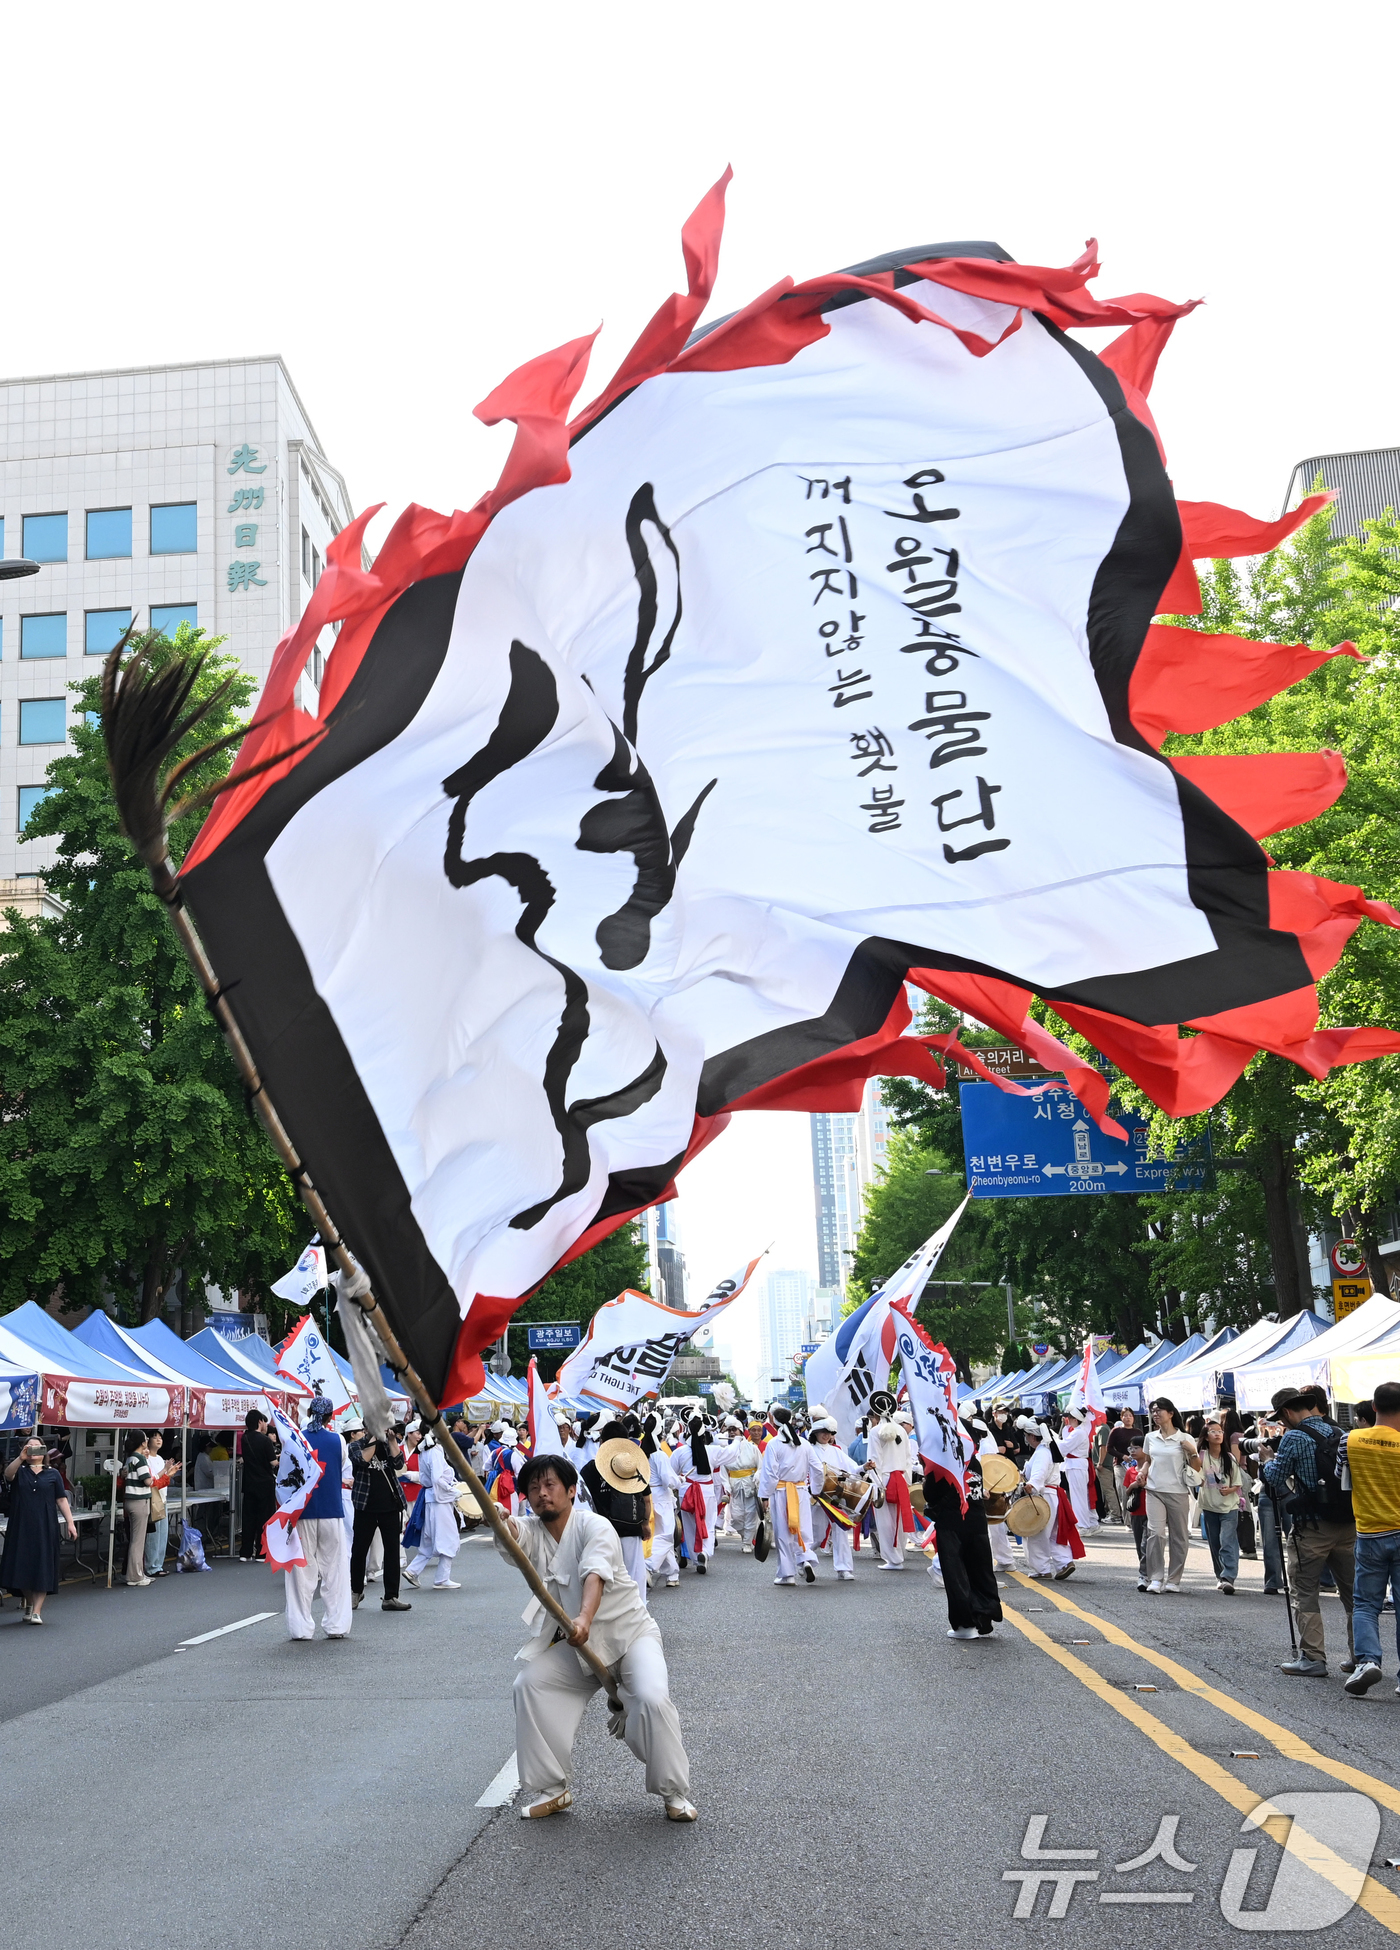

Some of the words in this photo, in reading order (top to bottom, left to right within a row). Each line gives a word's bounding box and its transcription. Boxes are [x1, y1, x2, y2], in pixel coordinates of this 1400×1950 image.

[227, 443, 267, 592] 光州日報
[975, 1050, 1024, 1065] 술의거리
[1034, 1102, 1075, 1120] 시청
[1076, 1134, 1089, 1159] 금남로
[969, 1153, 1039, 1172] 천변우로
[1070, 1165, 1100, 1175] 중앙로
[971, 1174, 1041, 1188] Cheonbyeonu-ro
[1069, 1180, 1106, 1192] 200m
[536, 1329, 573, 1338] 광주일보
